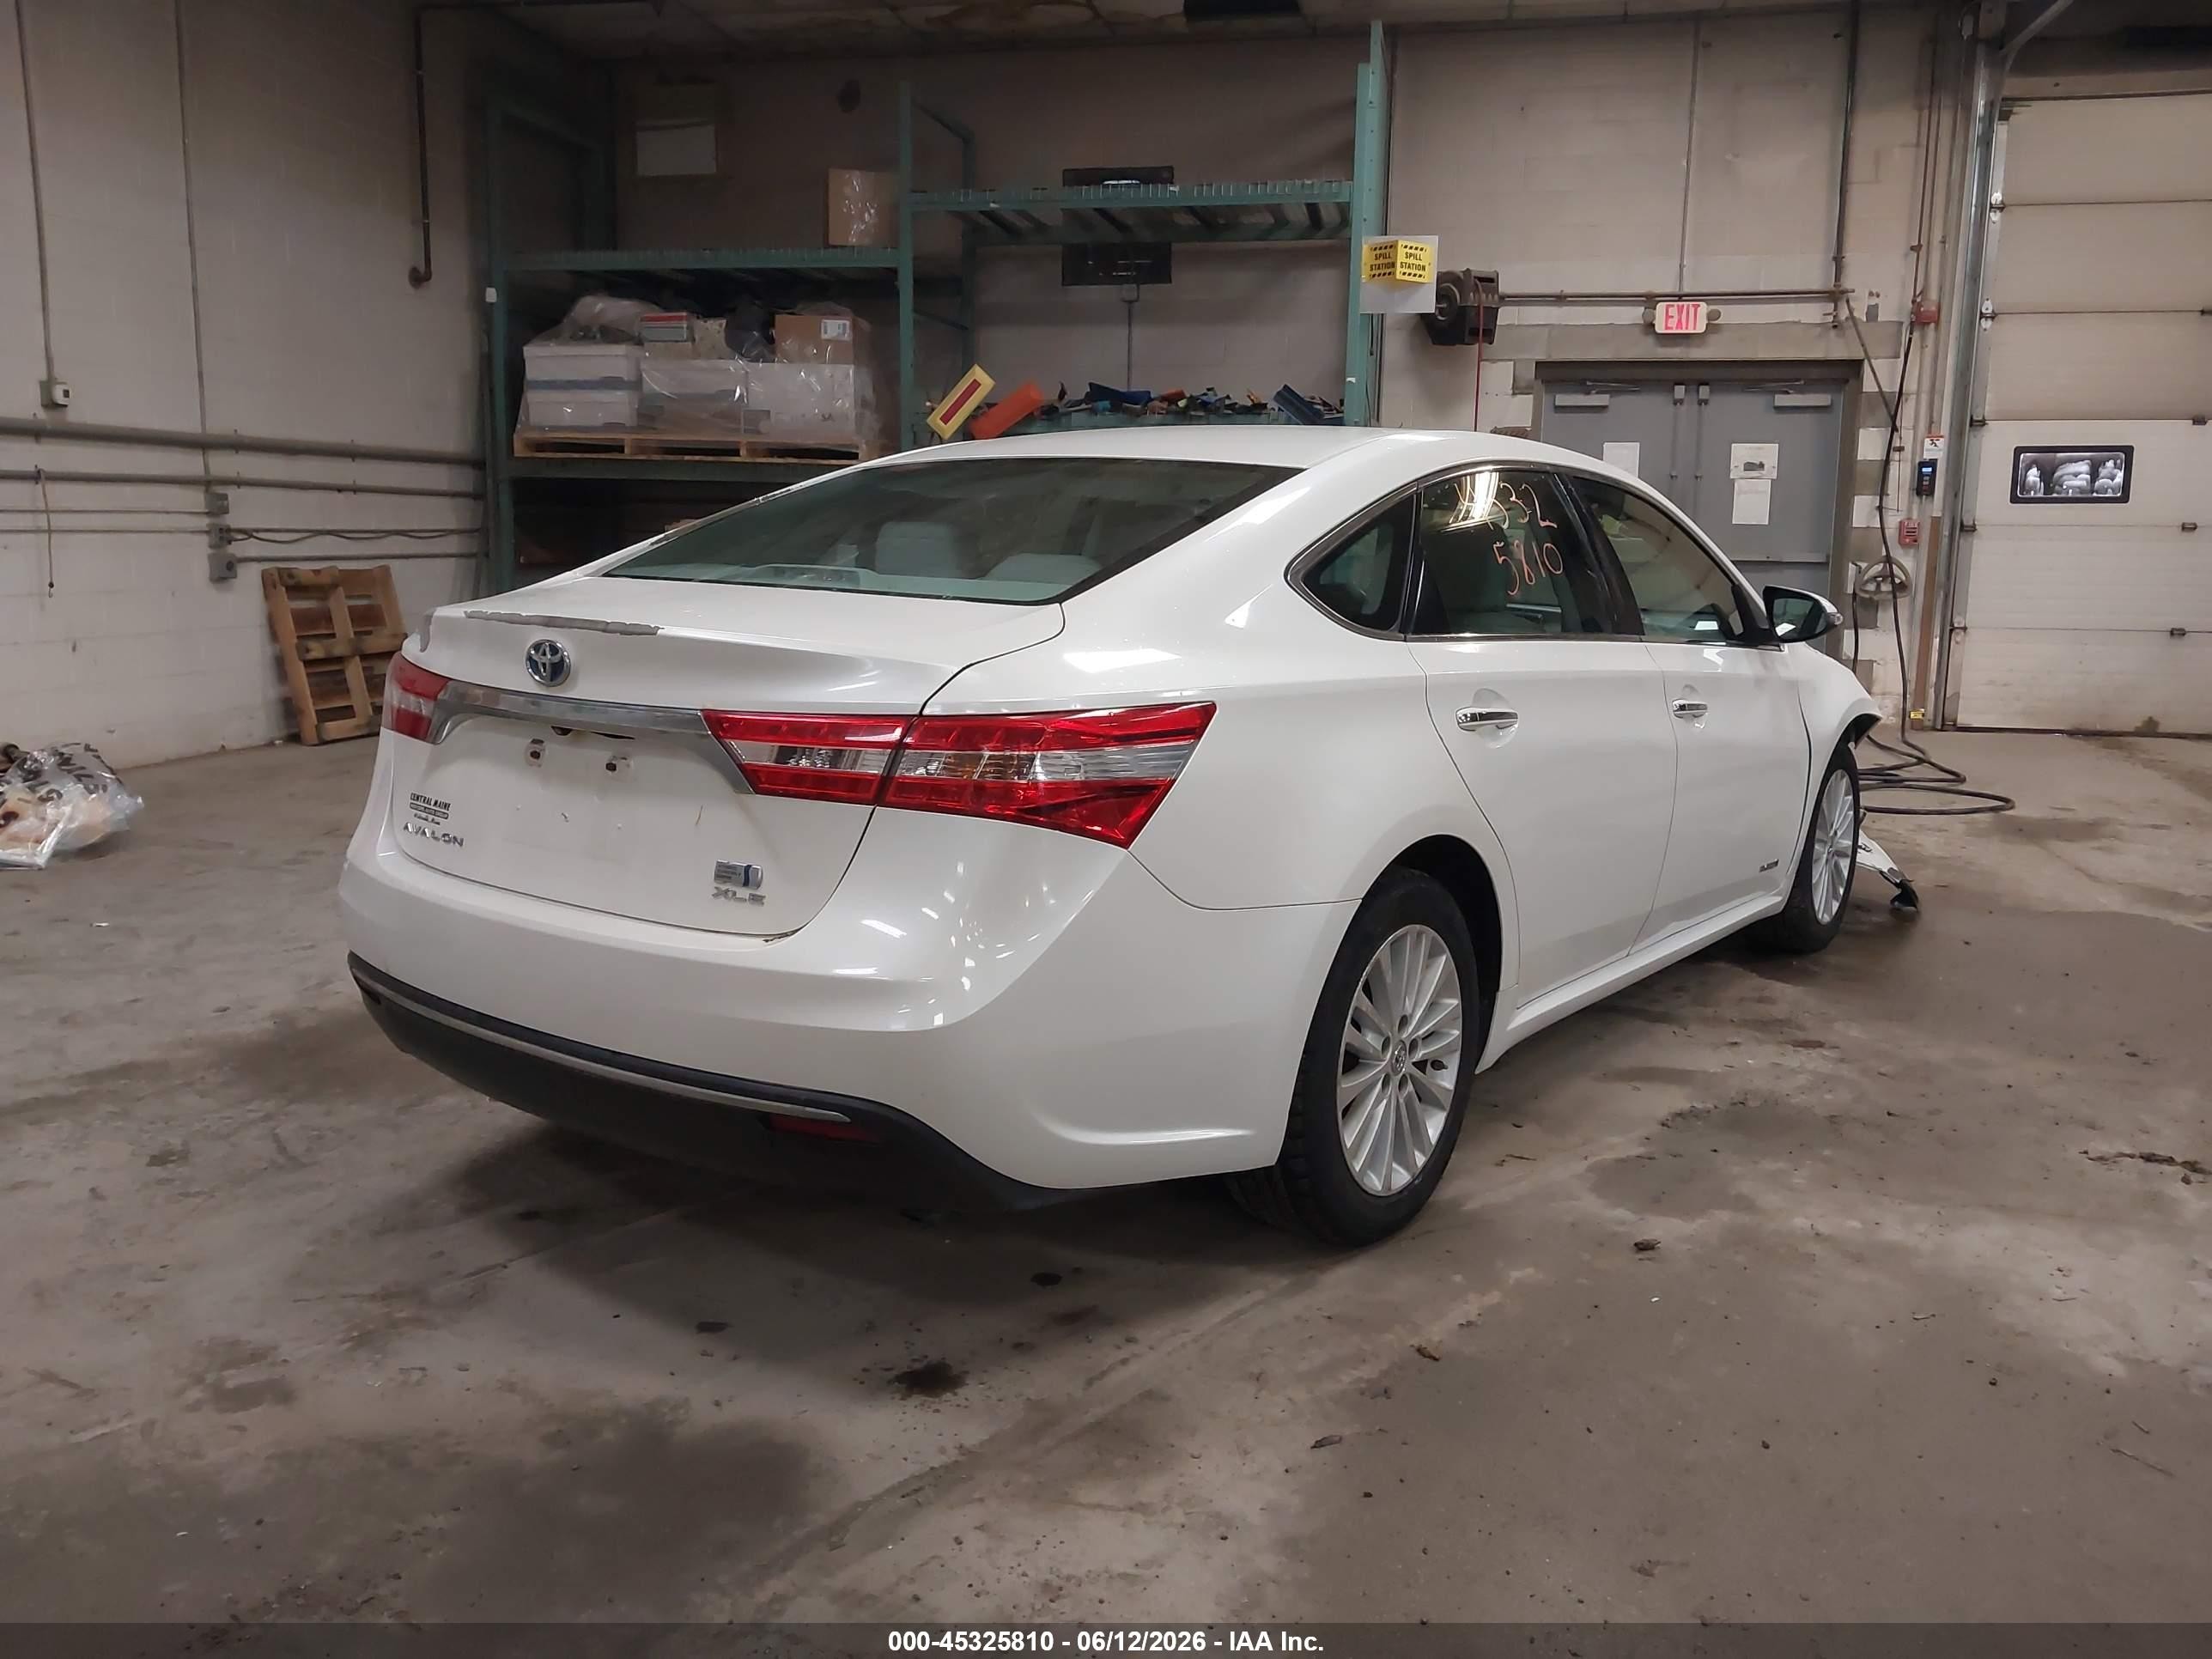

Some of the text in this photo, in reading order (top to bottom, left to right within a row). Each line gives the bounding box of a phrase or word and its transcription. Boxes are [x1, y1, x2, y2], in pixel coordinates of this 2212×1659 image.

[1400, 261, 1425, 271] STATION
[1405, 252, 1422, 261] SPILL
[1370, 262, 1395, 271] STATION
[1664, 303, 1701, 331] EXIT
[1492, 538, 1564, 595] 5810
[410, 793, 451, 811] CENTRAL MAINE
[404, 822, 465, 847] AVALON
[712, 886, 766, 906] XLE
